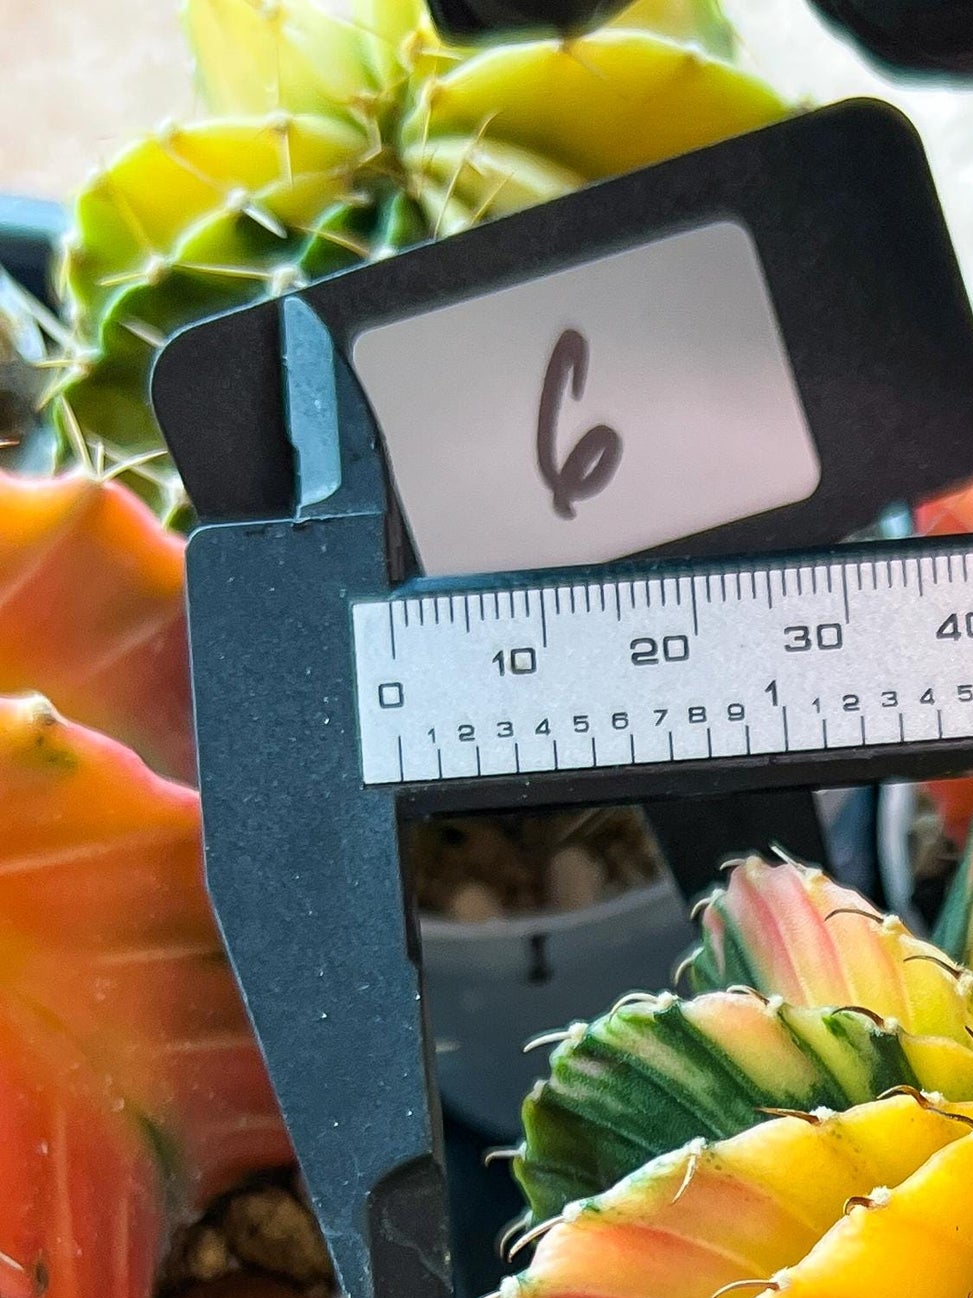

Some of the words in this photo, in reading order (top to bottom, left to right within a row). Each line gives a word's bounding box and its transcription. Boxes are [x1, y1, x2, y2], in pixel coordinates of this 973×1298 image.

[537, 328, 623, 519] 6
[378, 682, 404, 709] 0
[492, 647, 537, 676] 10
[630, 635, 689, 666] 20
[784, 623, 843, 652] 30
[427, 727, 436, 744] 1
[458, 725, 476, 743] 2
[496, 721, 514, 739] 3
[535, 718, 552, 736] 4
[573, 715, 590, 734] 5
[611, 712, 630, 731] 6
[653, 709, 669, 727] 7
[688, 706, 708, 724] 8
[726, 703, 746, 722] 9
[764, 680, 779, 707] 1
[811, 697, 821, 714] 1
[842, 694, 861, 712] 2
[881, 691, 899, 708] 3
[919, 688, 936, 706] 4
[956, 685, 973, 703] 5
